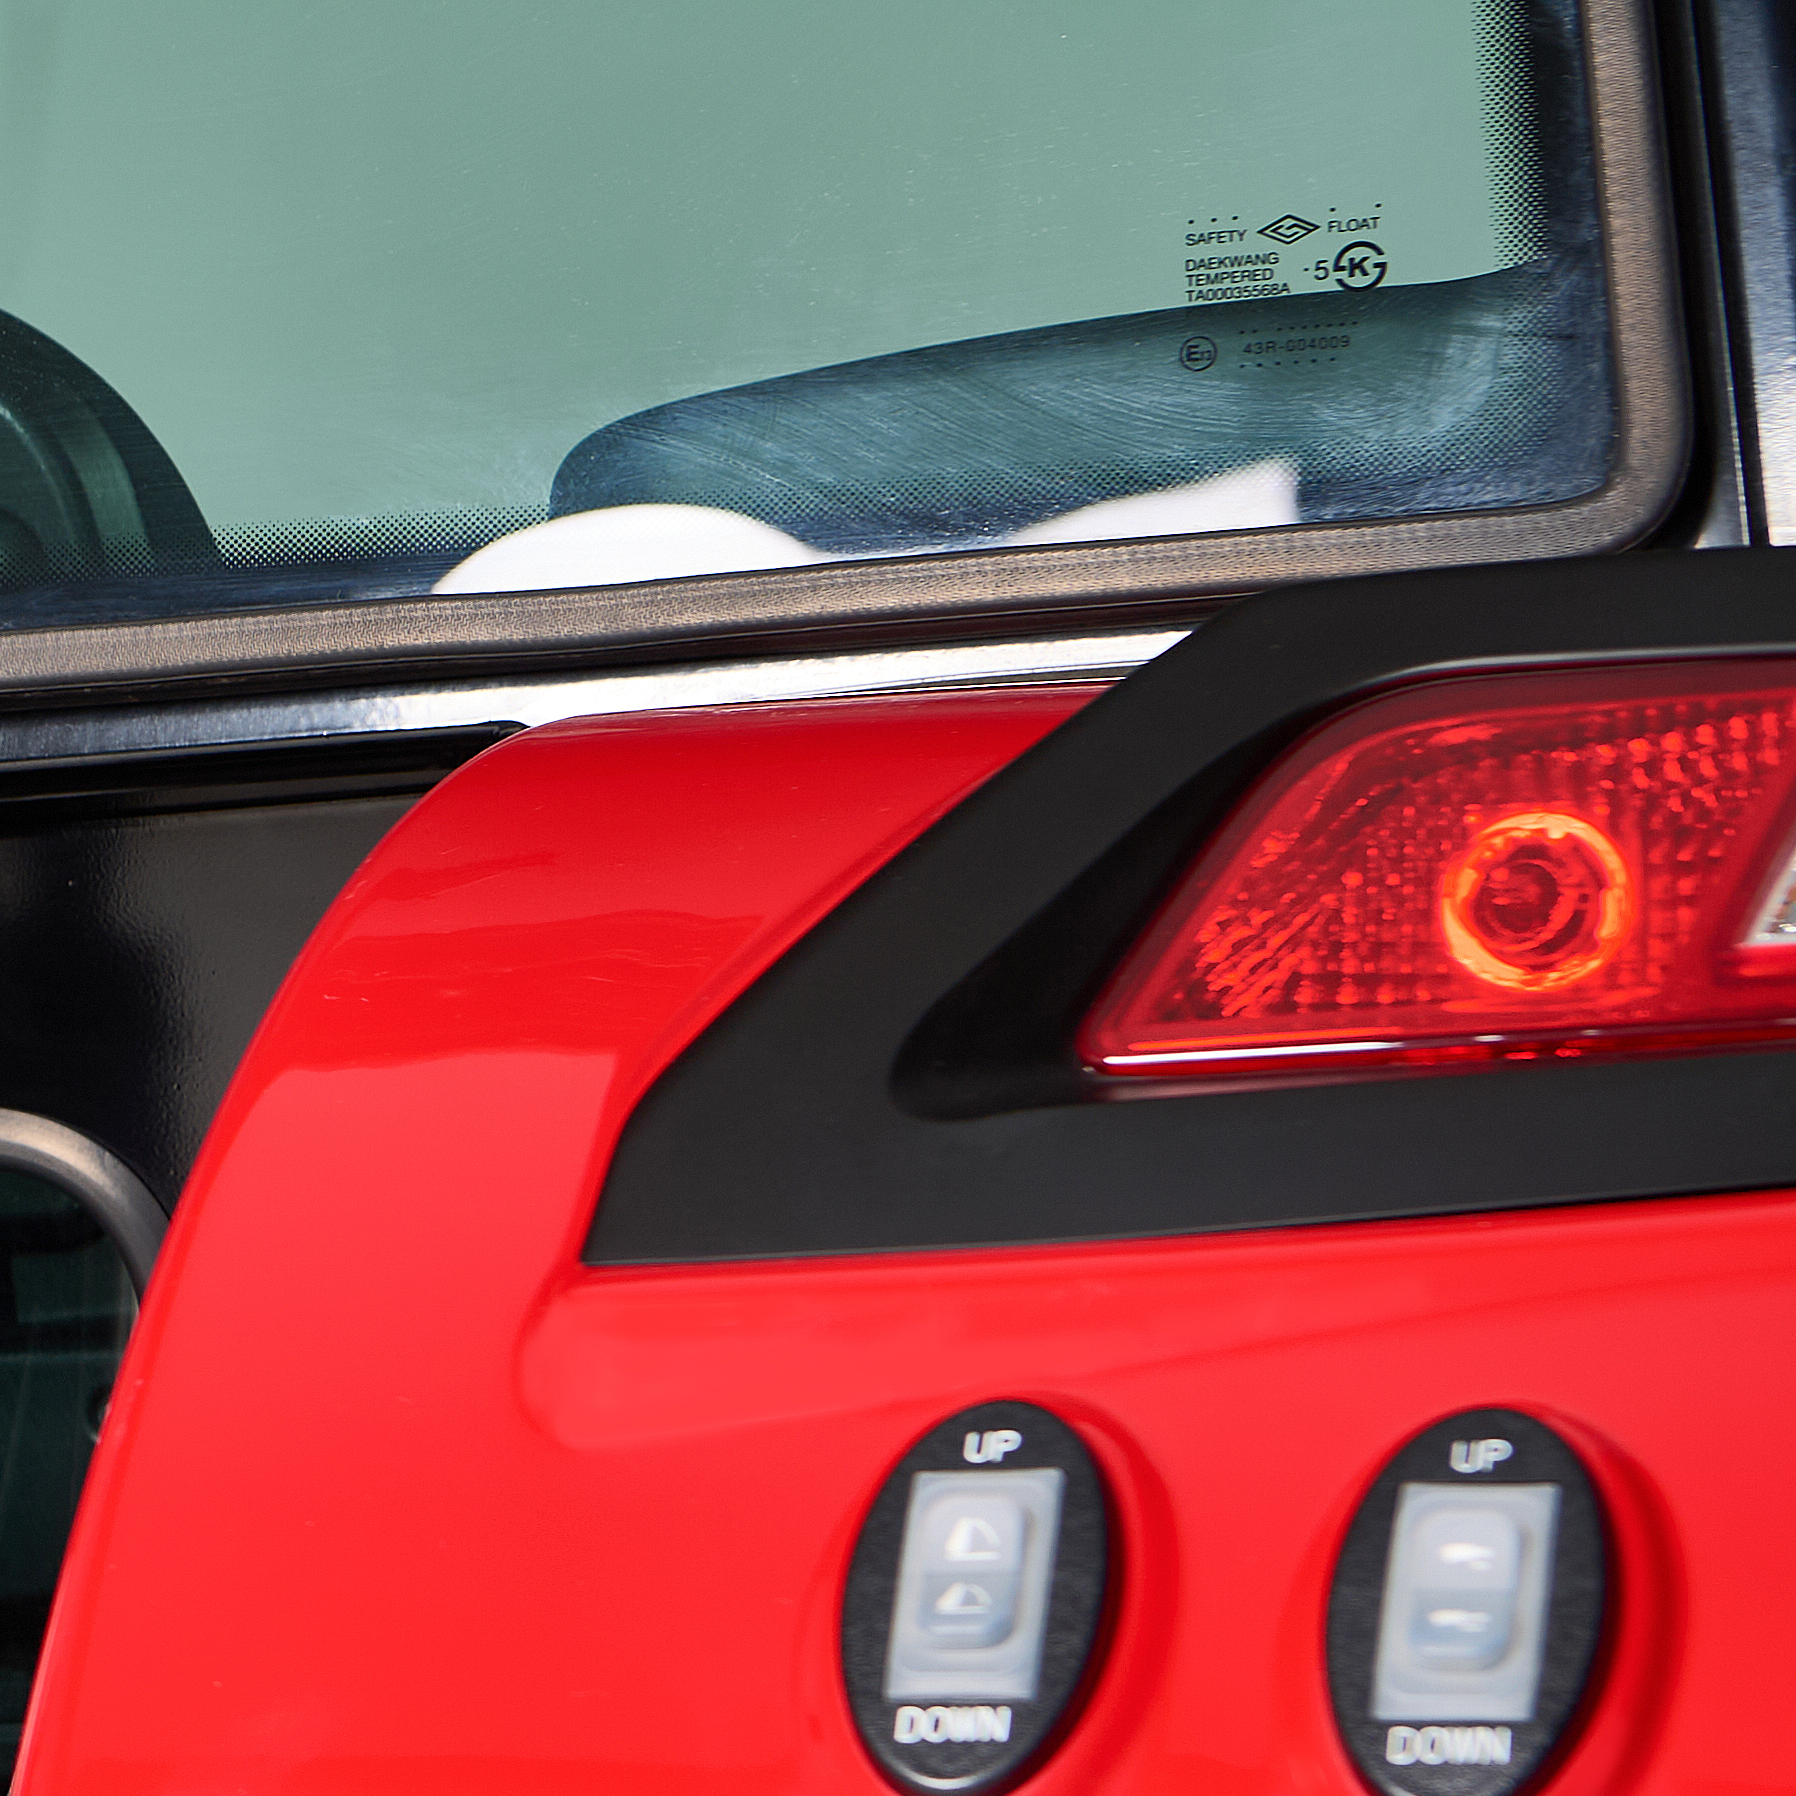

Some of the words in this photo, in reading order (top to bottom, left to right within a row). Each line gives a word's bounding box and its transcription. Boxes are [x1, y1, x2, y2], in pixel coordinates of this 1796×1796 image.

[1185, 229, 1248, 247] SAFETY
[1327, 216, 1381, 233] FLOAT
[1185, 252, 1280, 272] DAEKWANG
[1185, 268, 1274, 287] TEMPERED
[962, 1429, 1023, 1465] UP
[1450, 1438, 1514, 1474] UP
[893, 1705, 1012, 1744] DOWN
[1385, 1725, 1513, 1767] DOWN
